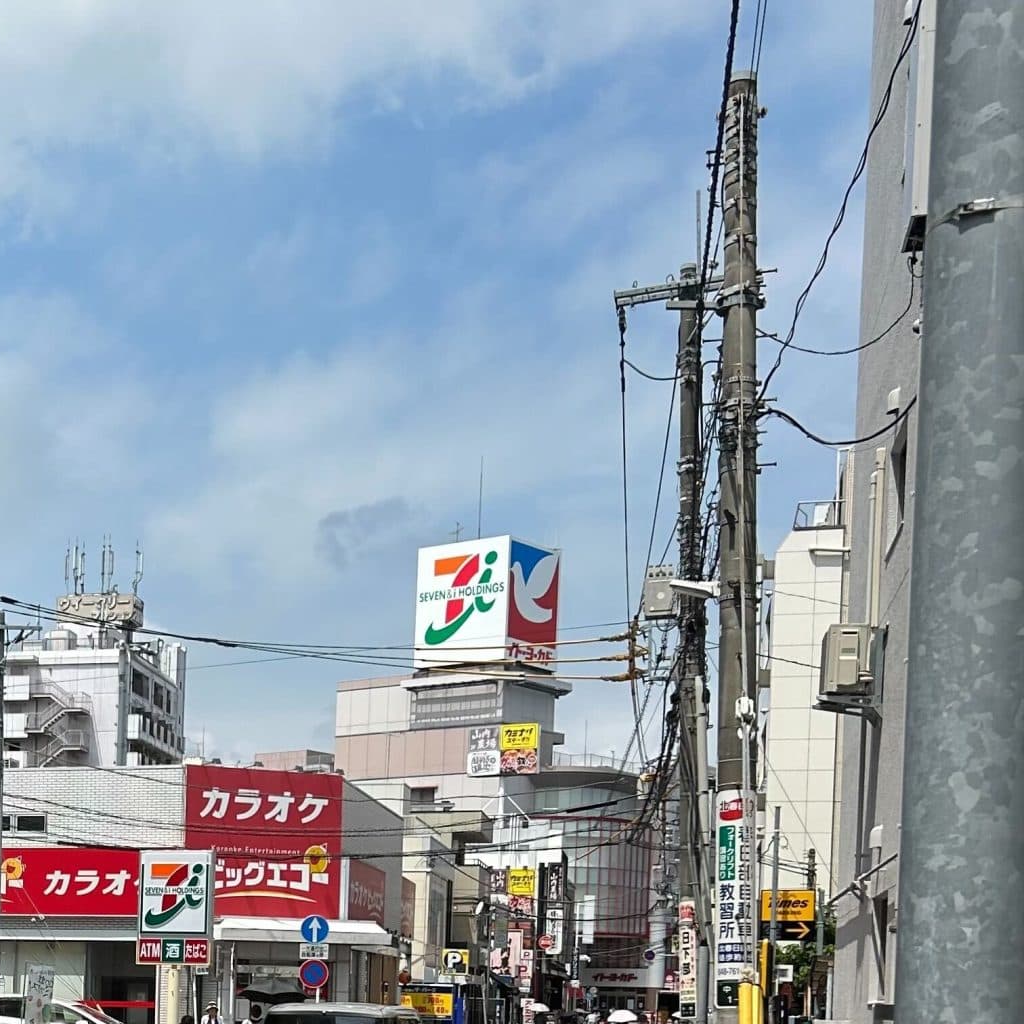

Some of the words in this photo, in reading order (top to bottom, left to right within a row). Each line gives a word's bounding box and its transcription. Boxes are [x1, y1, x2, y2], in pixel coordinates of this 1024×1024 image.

[458, 581, 505, 598] HOLDINGS
[199, 786, 329, 824] カラオケ
[211, 844, 242, 853] Karaoke
[244, 846, 301, 855] Entertainment
[43, 869, 139, 896] カラオ
[172, 886, 204, 894] HOLDINGS
[719, 883, 735, 939] 教習所
[140, 943, 160, 958] ATM
[166, 943, 181, 959] 酒
[185, 943, 207, 959] たばこ
